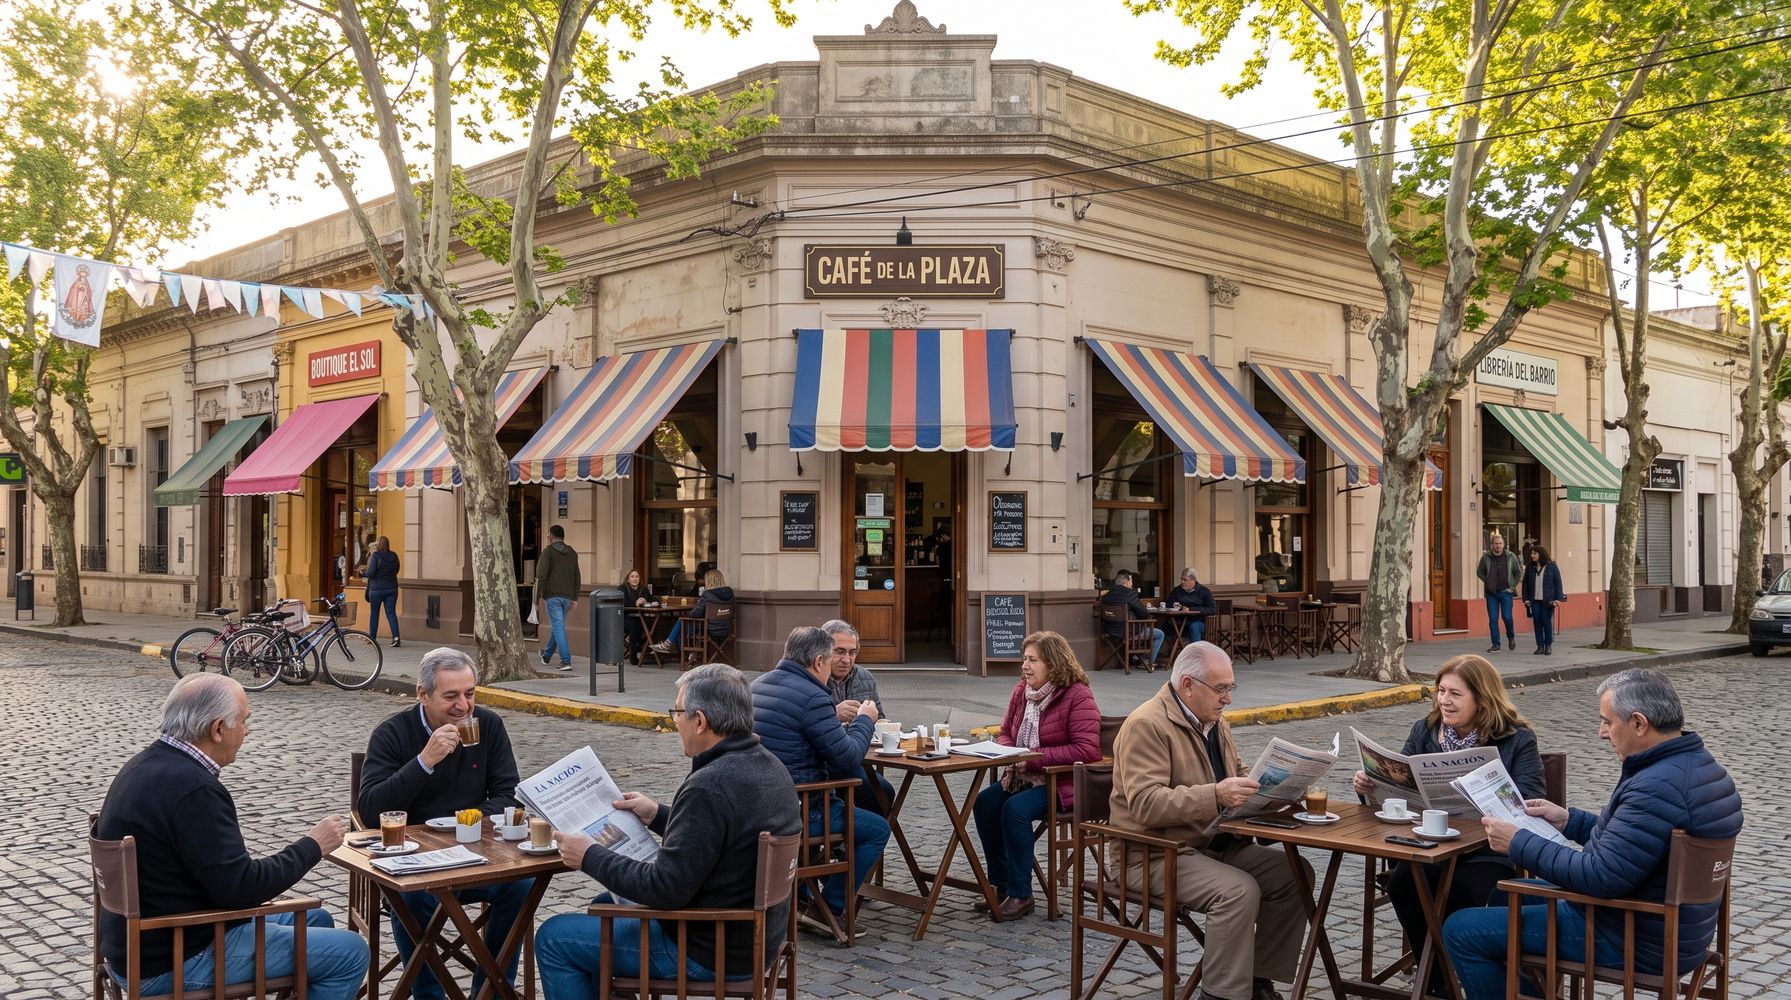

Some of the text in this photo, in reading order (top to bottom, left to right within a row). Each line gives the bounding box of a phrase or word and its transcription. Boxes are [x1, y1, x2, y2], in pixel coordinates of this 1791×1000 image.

[818, 250, 991, 285] CAFÉ DE LA PLAZA
[311, 347, 376, 379] BOUTIQUE EL SOL
[1480, 355, 1556, 386] LIBRERÍA DEL BARRIO
[1440, 755, 1486, 767] NACIÓN
[534, 784, 548, 793] LA
[546, 762, 583, 787] NACIÓN
